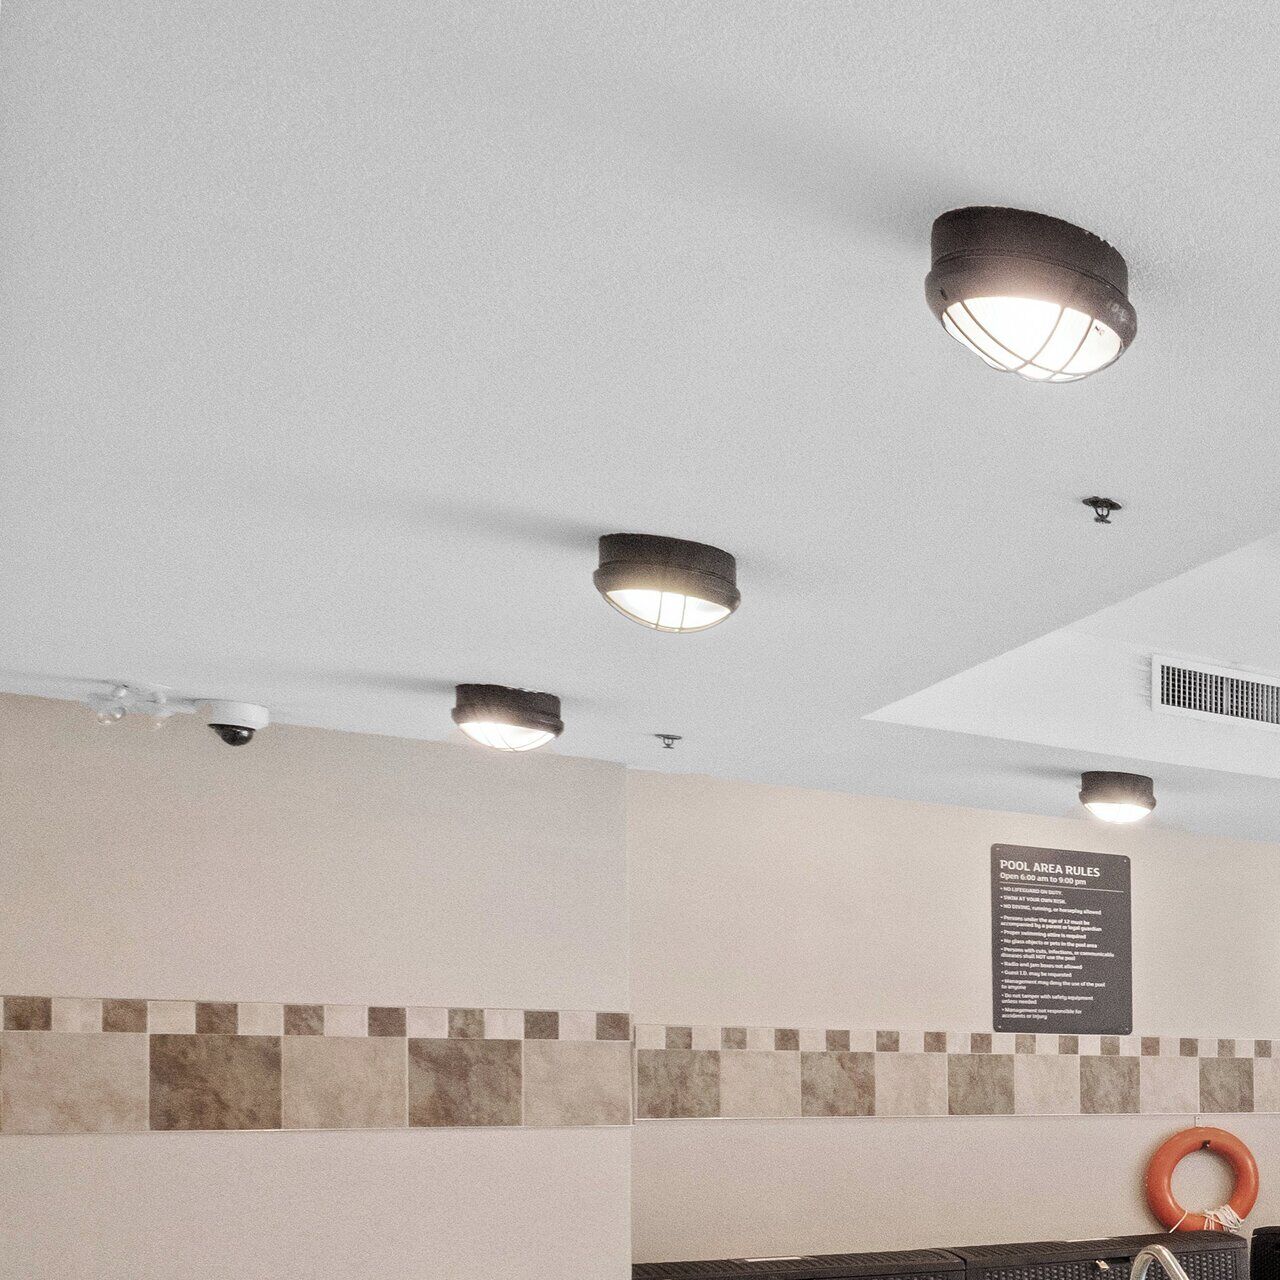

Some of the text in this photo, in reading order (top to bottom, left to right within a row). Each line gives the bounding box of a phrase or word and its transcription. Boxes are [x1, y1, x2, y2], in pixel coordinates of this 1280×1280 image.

[1000, 860, 1100, 877] POOL AREA RULES
[1000, 872, 1019, 880] Open
